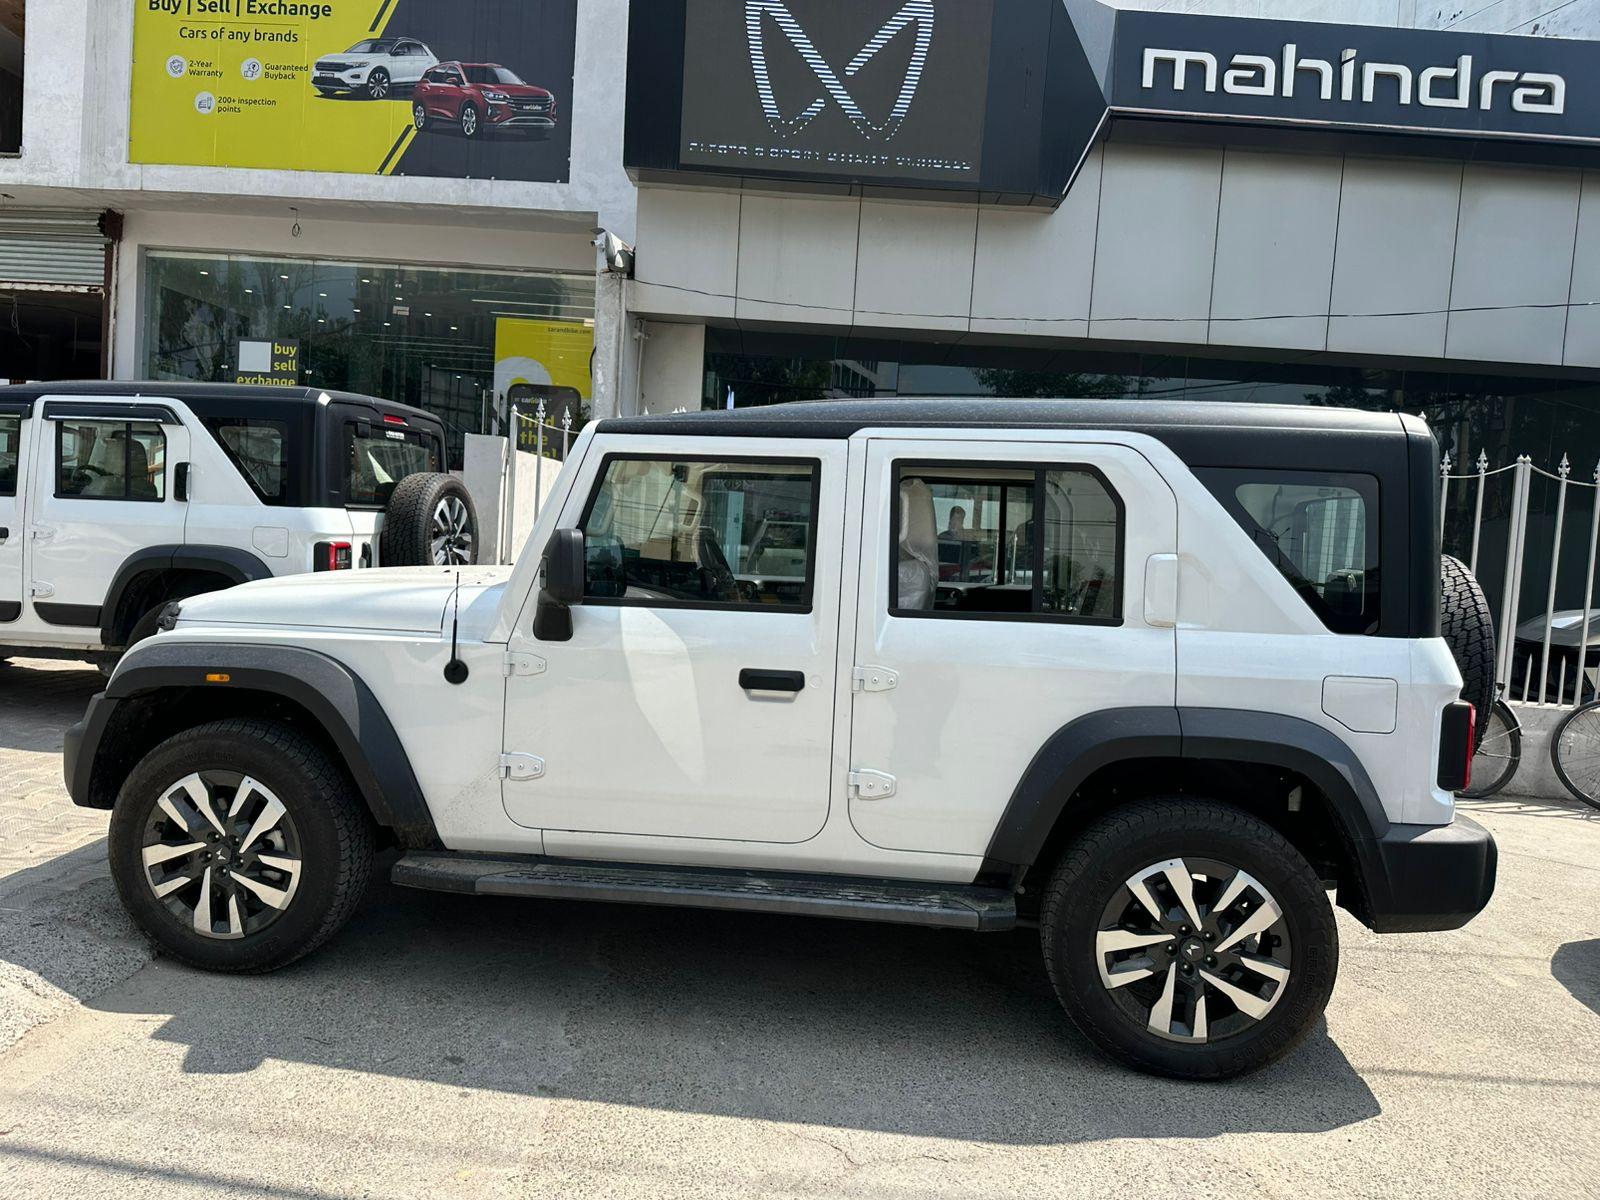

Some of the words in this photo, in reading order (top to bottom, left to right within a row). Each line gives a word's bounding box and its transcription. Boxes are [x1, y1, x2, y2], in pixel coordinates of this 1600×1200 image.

[149, 0, 181, 14] Buy
[197, 0, 231, 13] Sell
[246, 0, 332, 19] Exchange
[179, 27, 207, 39] Cars
[211, 27, 225, 40] of
[228, 31, 250, 42] any
[254, 29, 299, 42] brands
[189, 60, 213, 68] 2-Year
[264, 63, 309, 72] Guaranteed
[188, 69, 223, 78] Warranty
[264, 72, 296, 80] Buyback
[1142, 43, 1566, 115] mahindra
[218, 96, 236, 104] 200+
[237, 97, 277, 106] inspection
[217, 105, 241, 113] points
[274, 342, 297, 357] buy
[274, 360, 297, 371] sell
[236, 374, 296, 387] exchange
